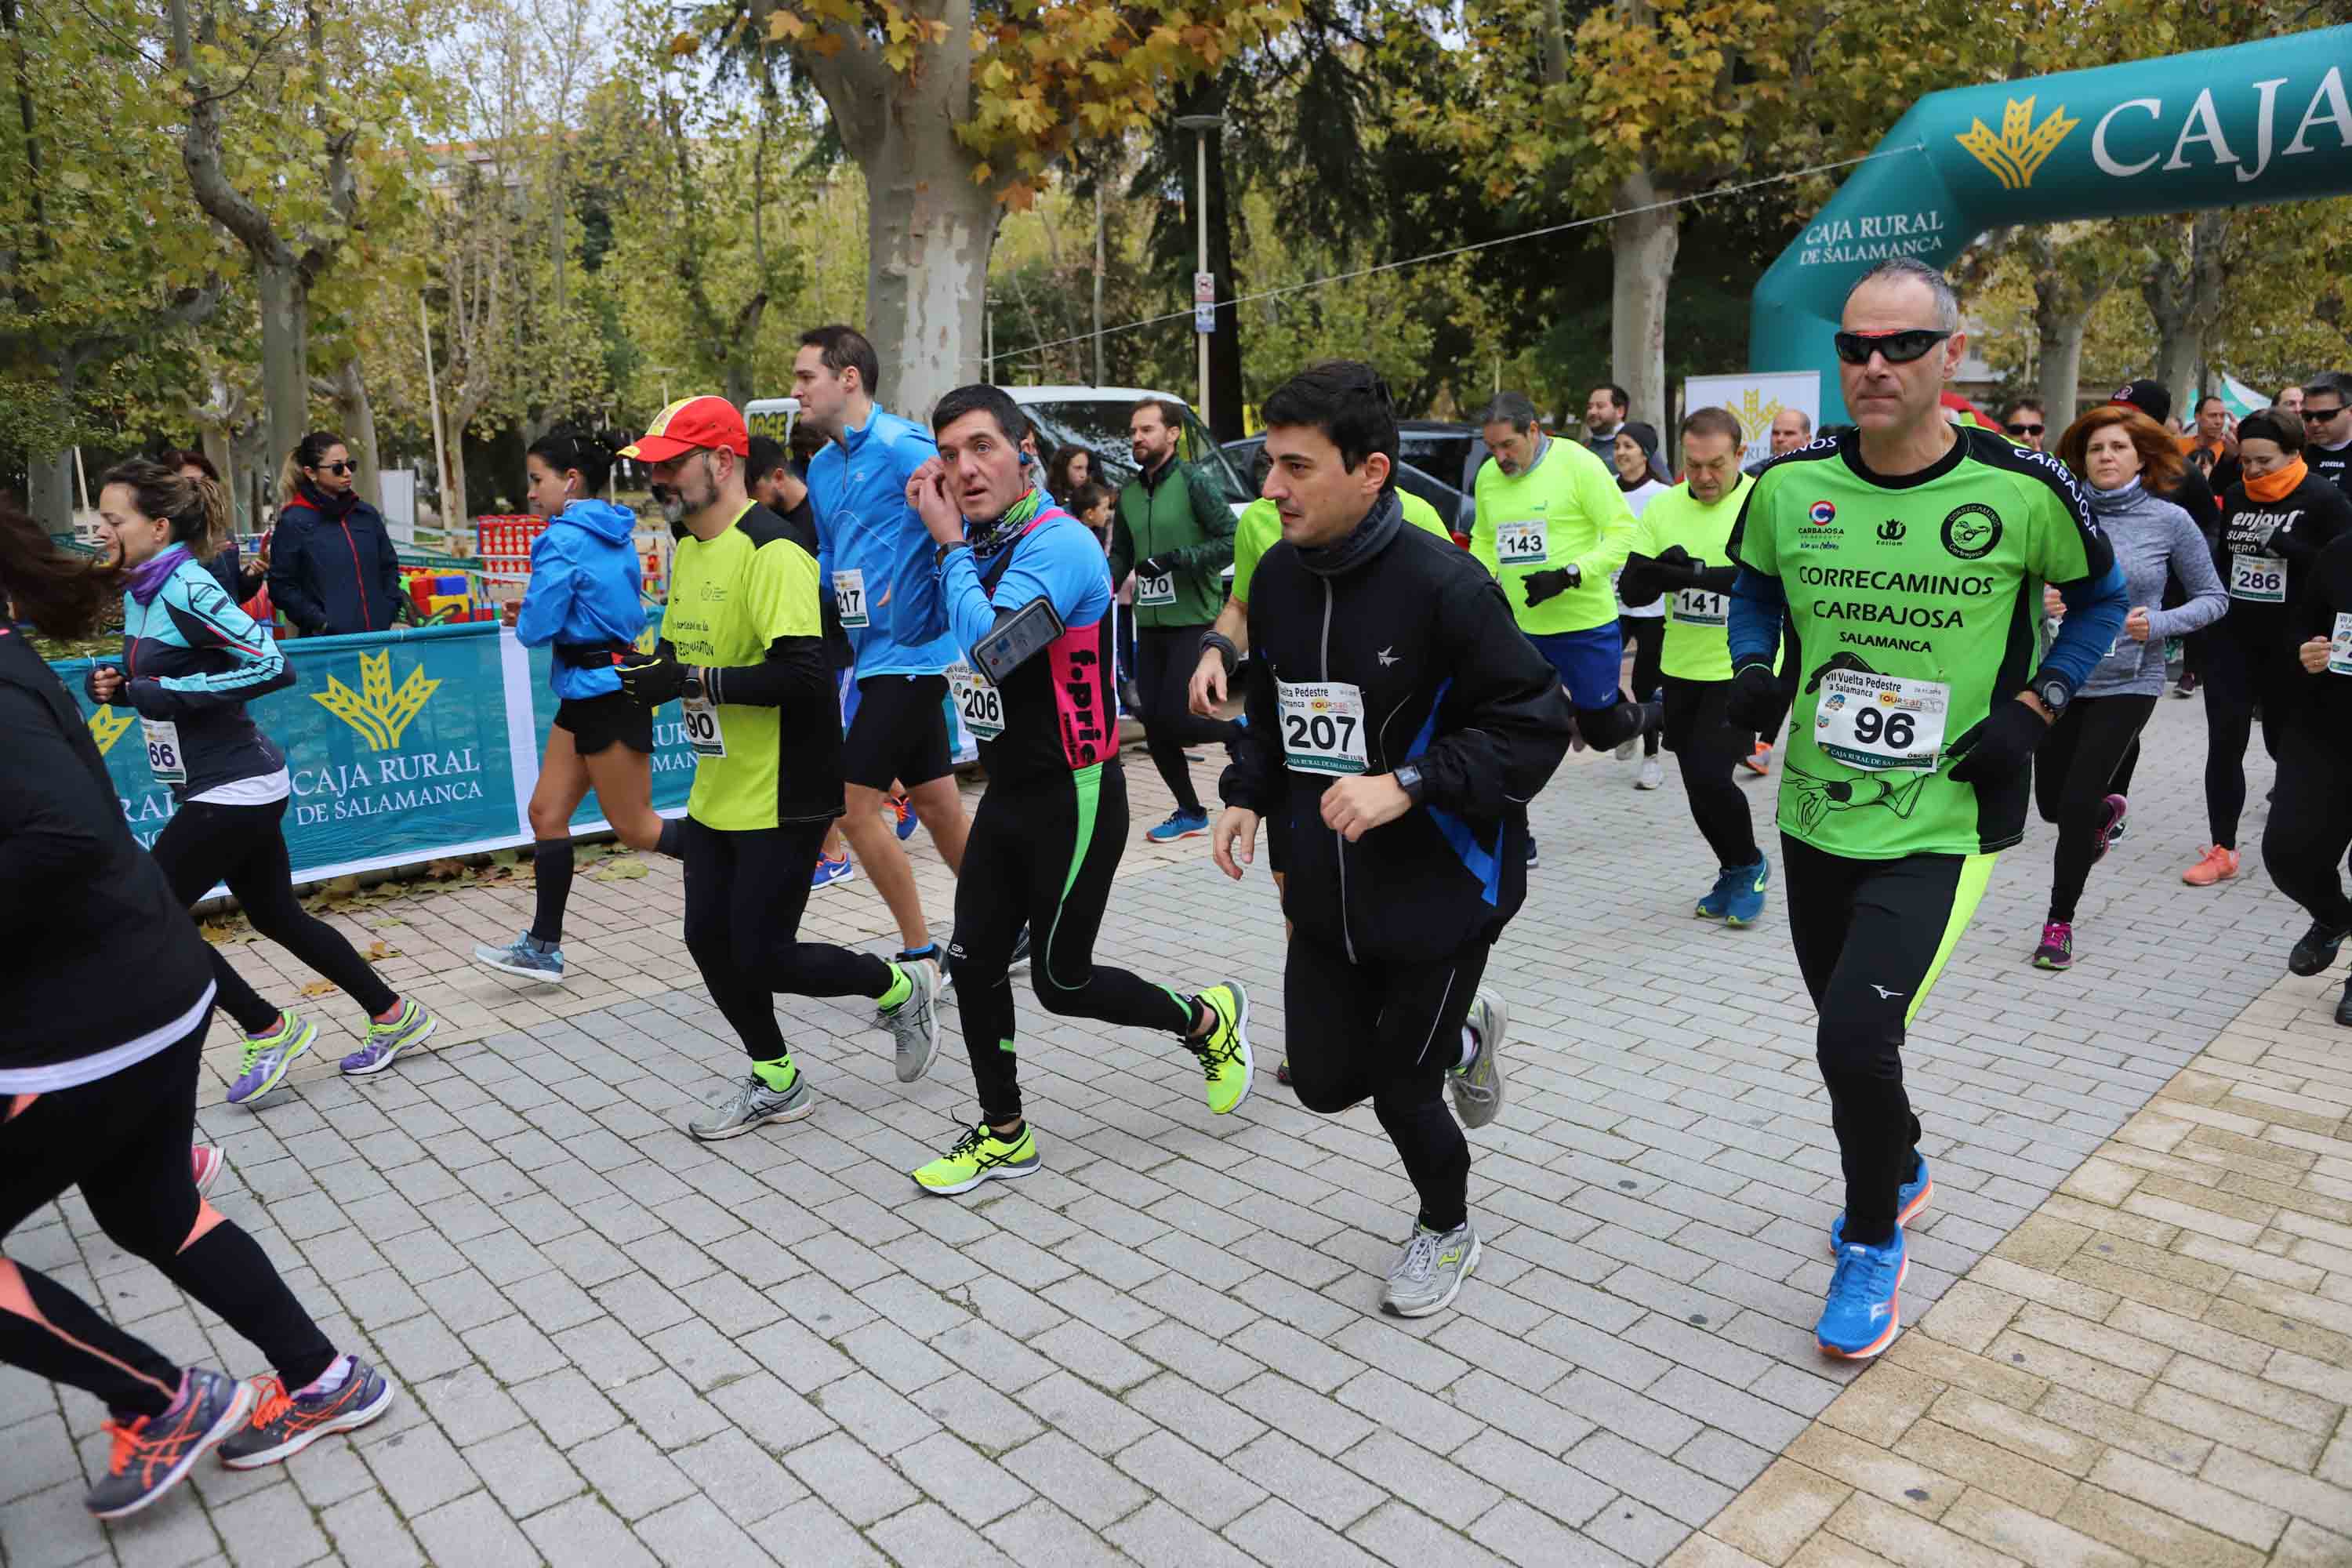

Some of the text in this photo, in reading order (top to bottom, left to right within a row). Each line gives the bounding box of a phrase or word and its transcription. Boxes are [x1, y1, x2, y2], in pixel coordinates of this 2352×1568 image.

[2091, 66, 2352, 182] CAJA
[1806, 211, 1944, 246] CAJA RURAL
[1800, 236, 1943, 265] DE SALAMANCA
[1507, 535, 1543, 554] 143
[2227, 543, 2258, 554] HERO
[1799, 565, 1995, 596] CORRECAMINOS
[2238, 571, 2281, 591] 286
[1681, 591, 1720, 614] 141
[1813, 600, 1964, 629] CARBAJOSA
[1838, 630, 1933, 653] SALAMANCA
[1294, 687, 1330, 698] Pedestre
[1835, 682, 1874, 699] Salamanca
[1838, 671, 1864, 687] Vuelta
[1866, 677, 1902, 693] Pedestre
[963, 688, 1000, 722] 206
[685, 712, 715, 740] 90
[1286, 714, 1356, 753] 207
[1854, 706, 1915, 750] 96
[149, 742, 176, 768] 66
[1848, 752, 1871, 764] RURAL
[292, 747, 481, 798] CAJA RURAL
[295, 780, 485, 826] DE SALAMANCA
